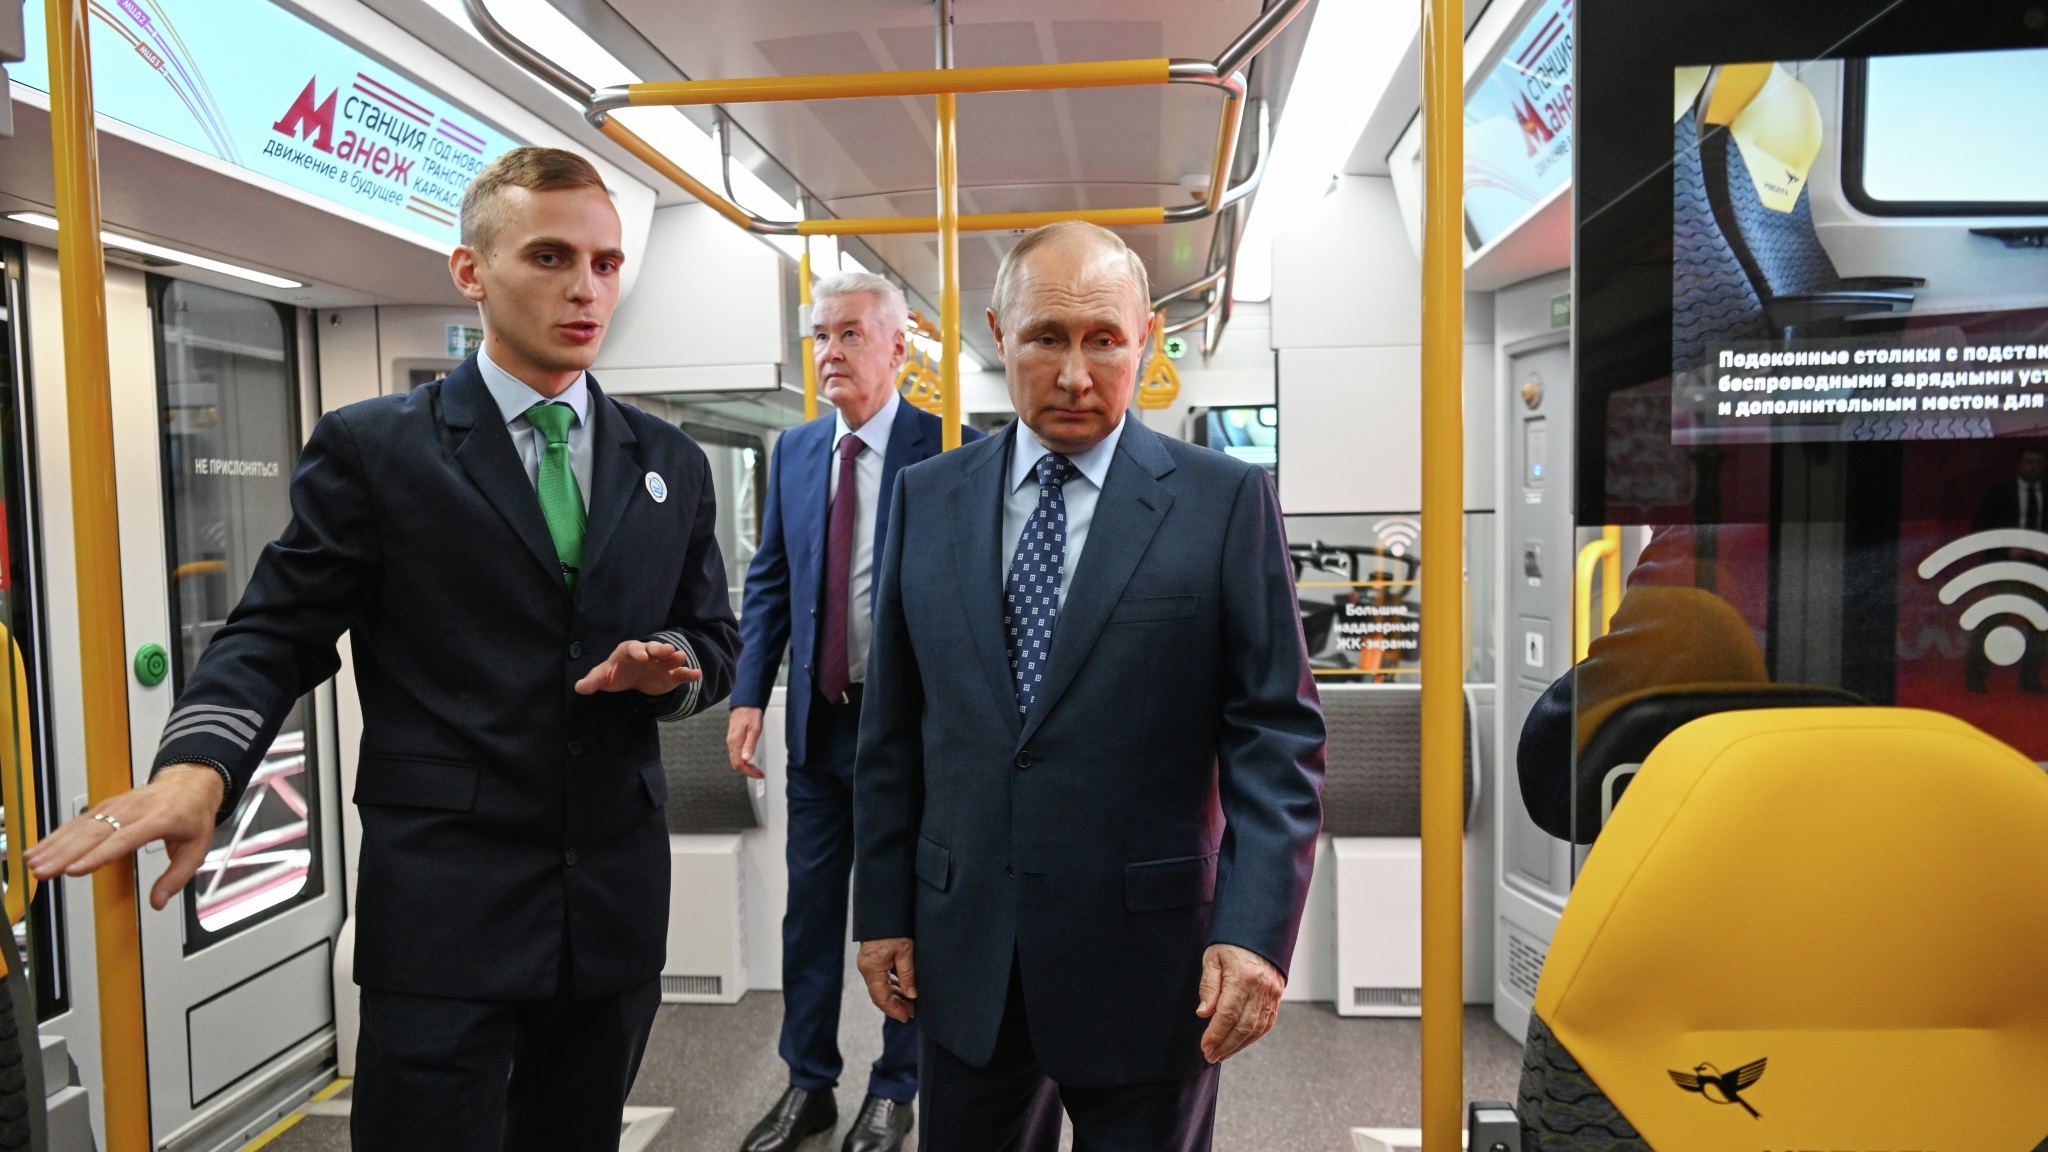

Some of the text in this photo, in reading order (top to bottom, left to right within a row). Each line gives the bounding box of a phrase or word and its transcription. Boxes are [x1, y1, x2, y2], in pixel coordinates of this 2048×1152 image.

[272, 74, 416, 187] Манеж
[428, 137, 488, 176] ГОД НОВО
[263, 139, 404, 206] движение в будущее
[1719, 350, 1849, 369] Подоконные
[1854, 347, 1941, 365] столики
[1946, 347, 1958, 361] с
[1718, 373, 1887, 394] беспроводными
[1891, 369, 2014, 390] зарядными
[1718, 393, 2044, 417] и дополнительным местом для
[195, 458, 279, 477] НЕ ПРИСЛОНЯТЬСЯ
[1345, 603, 1408, 617] Большие
[1333, 622, 1420, 635] наддверные
[1336, 638, 1417, 653] ЖК-экраны
